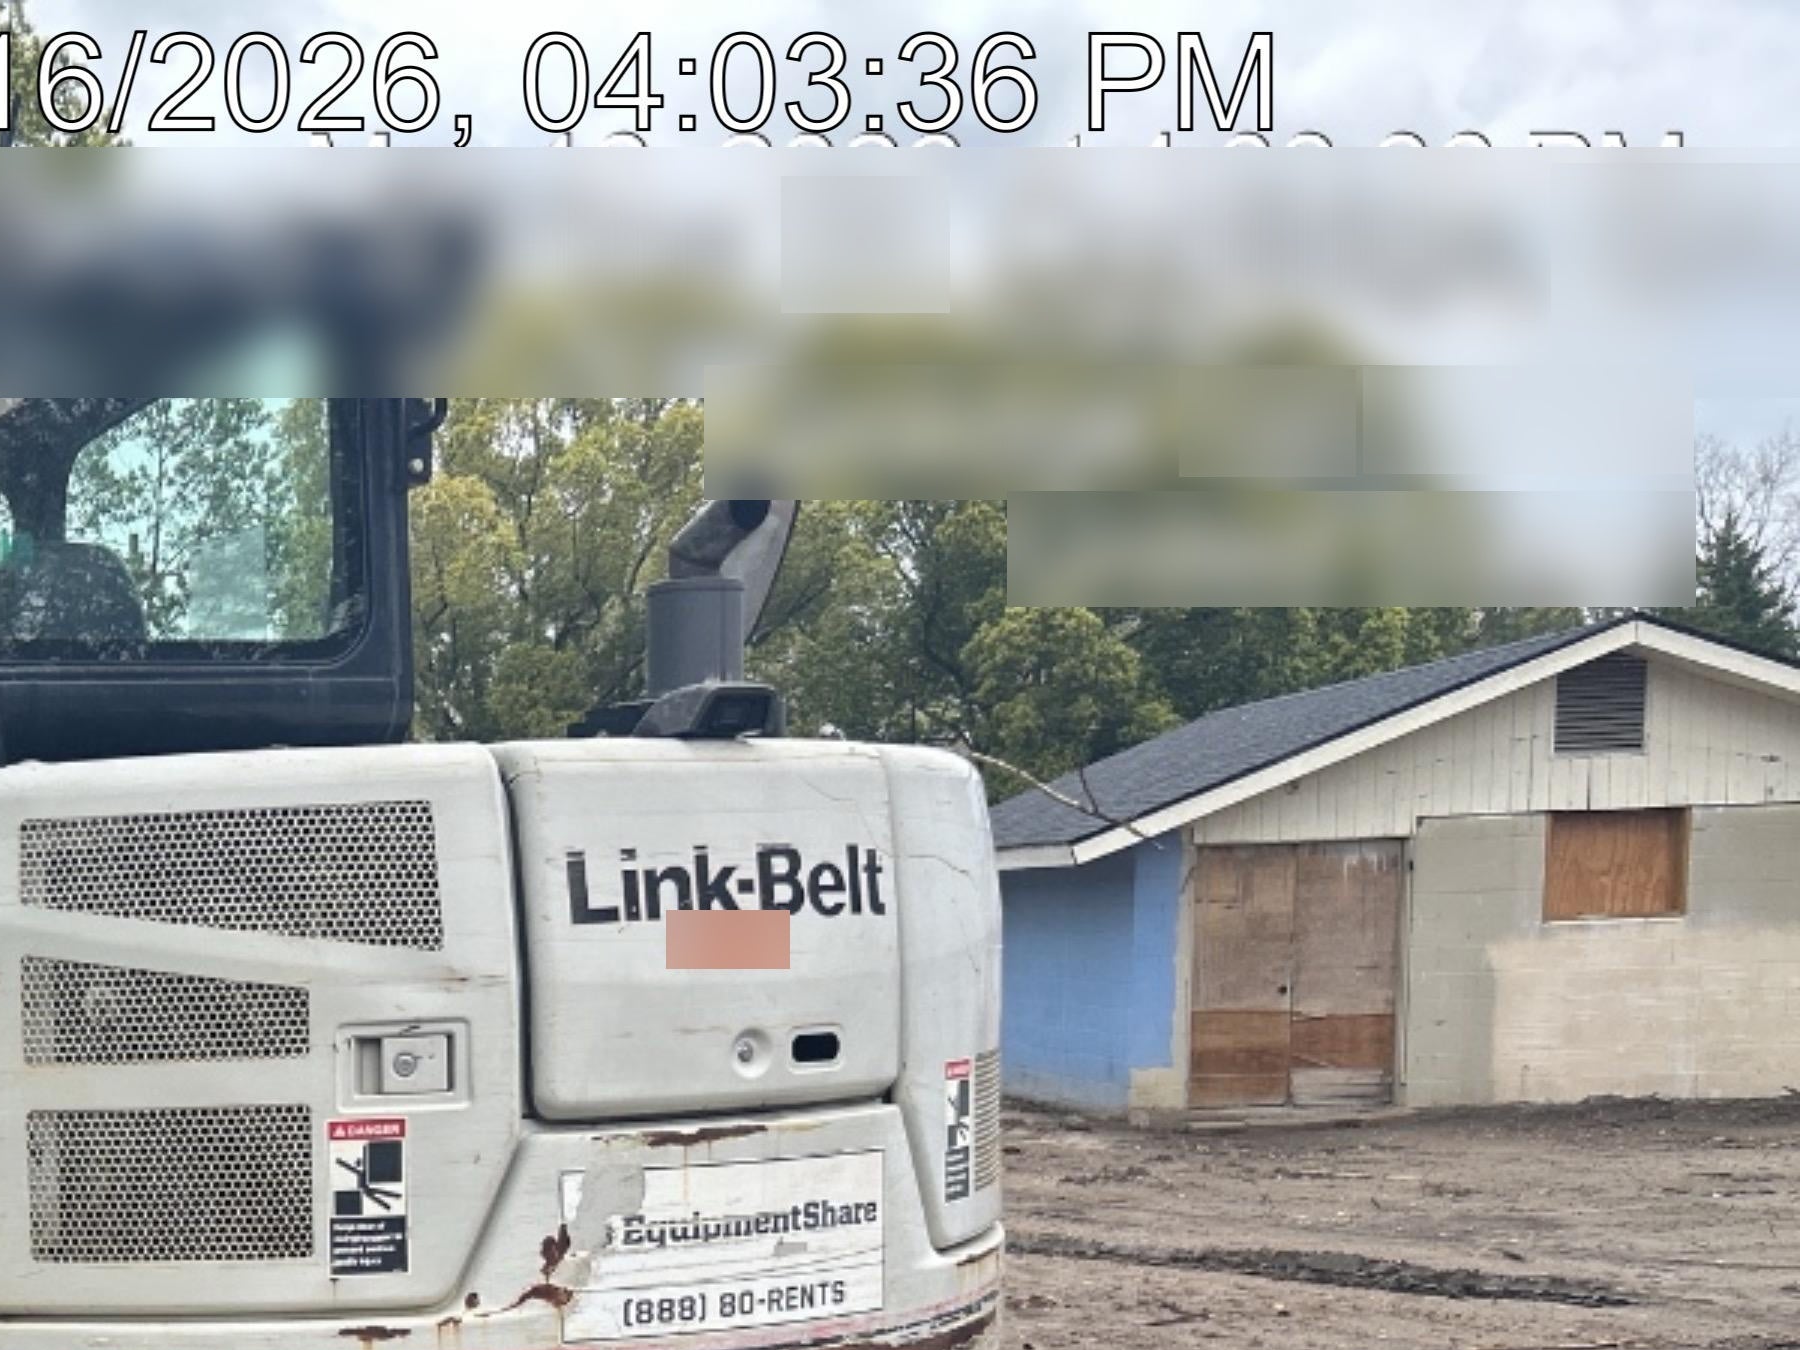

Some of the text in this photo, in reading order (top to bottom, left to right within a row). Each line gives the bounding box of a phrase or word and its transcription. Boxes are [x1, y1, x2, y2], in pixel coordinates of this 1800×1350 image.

[565, 843, 887, 925] Link-Belt
[347, 1123, 400, 1137] DANGER
[622, 1200, 878, 1248] EquipmentShare
[622, 1280, 846, 1327] (888) 80-RENTS
